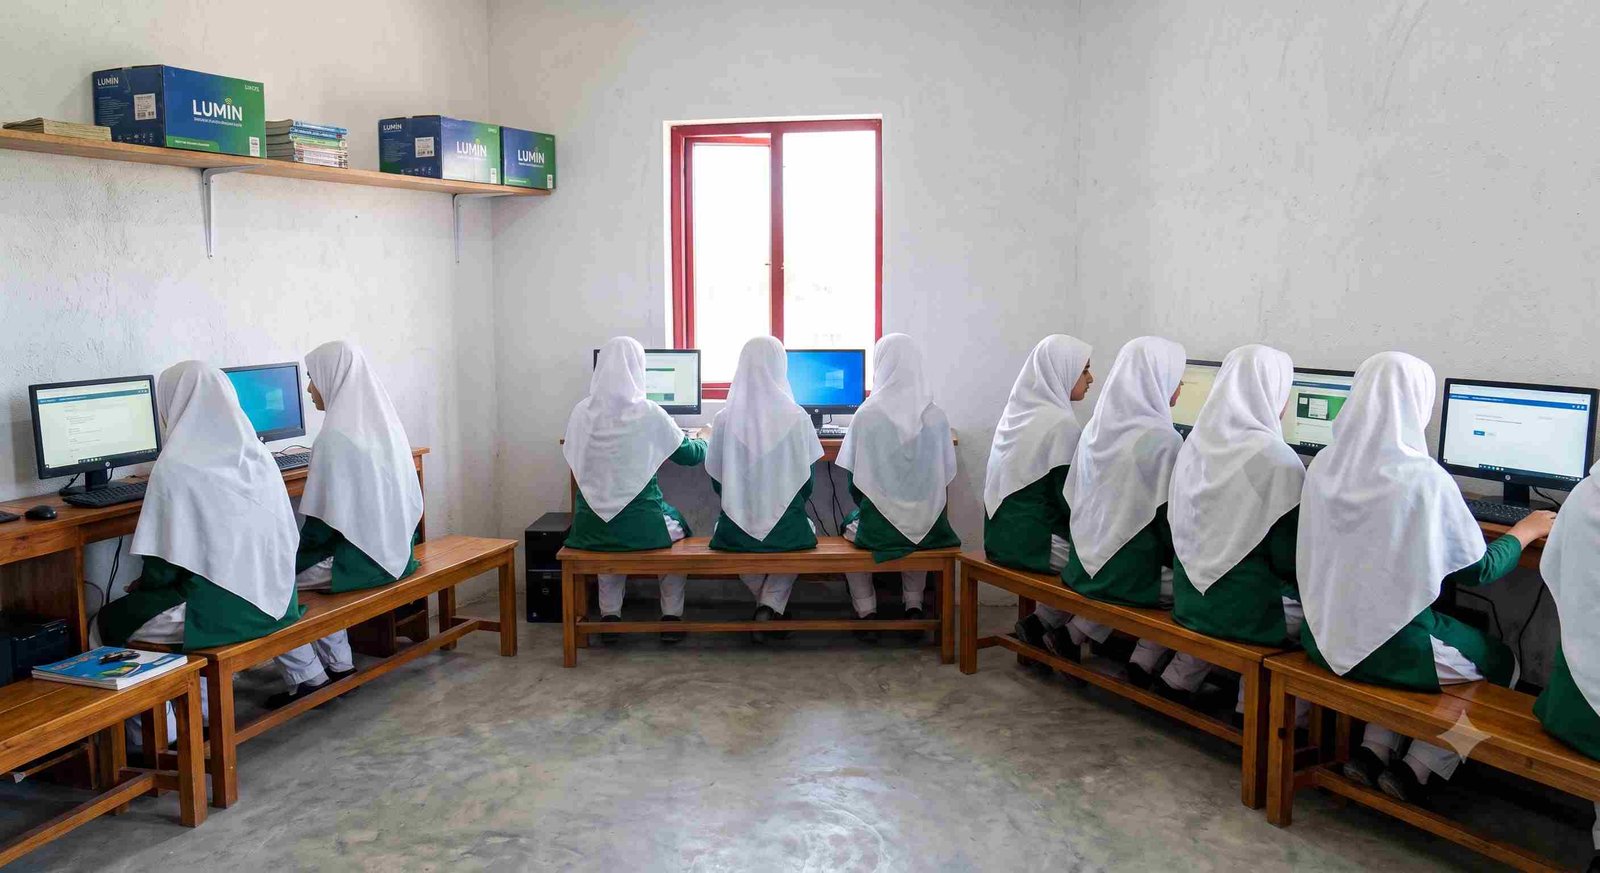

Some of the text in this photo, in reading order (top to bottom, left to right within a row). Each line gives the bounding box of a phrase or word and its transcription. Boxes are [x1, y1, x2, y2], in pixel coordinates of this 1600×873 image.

[97, 76, 119, 86] LUMIN
[192, 99, 243, 122] LUMIN
[456, 140, 487, 157] LUMIN
[517, 149, 545, 165] LUMIN
